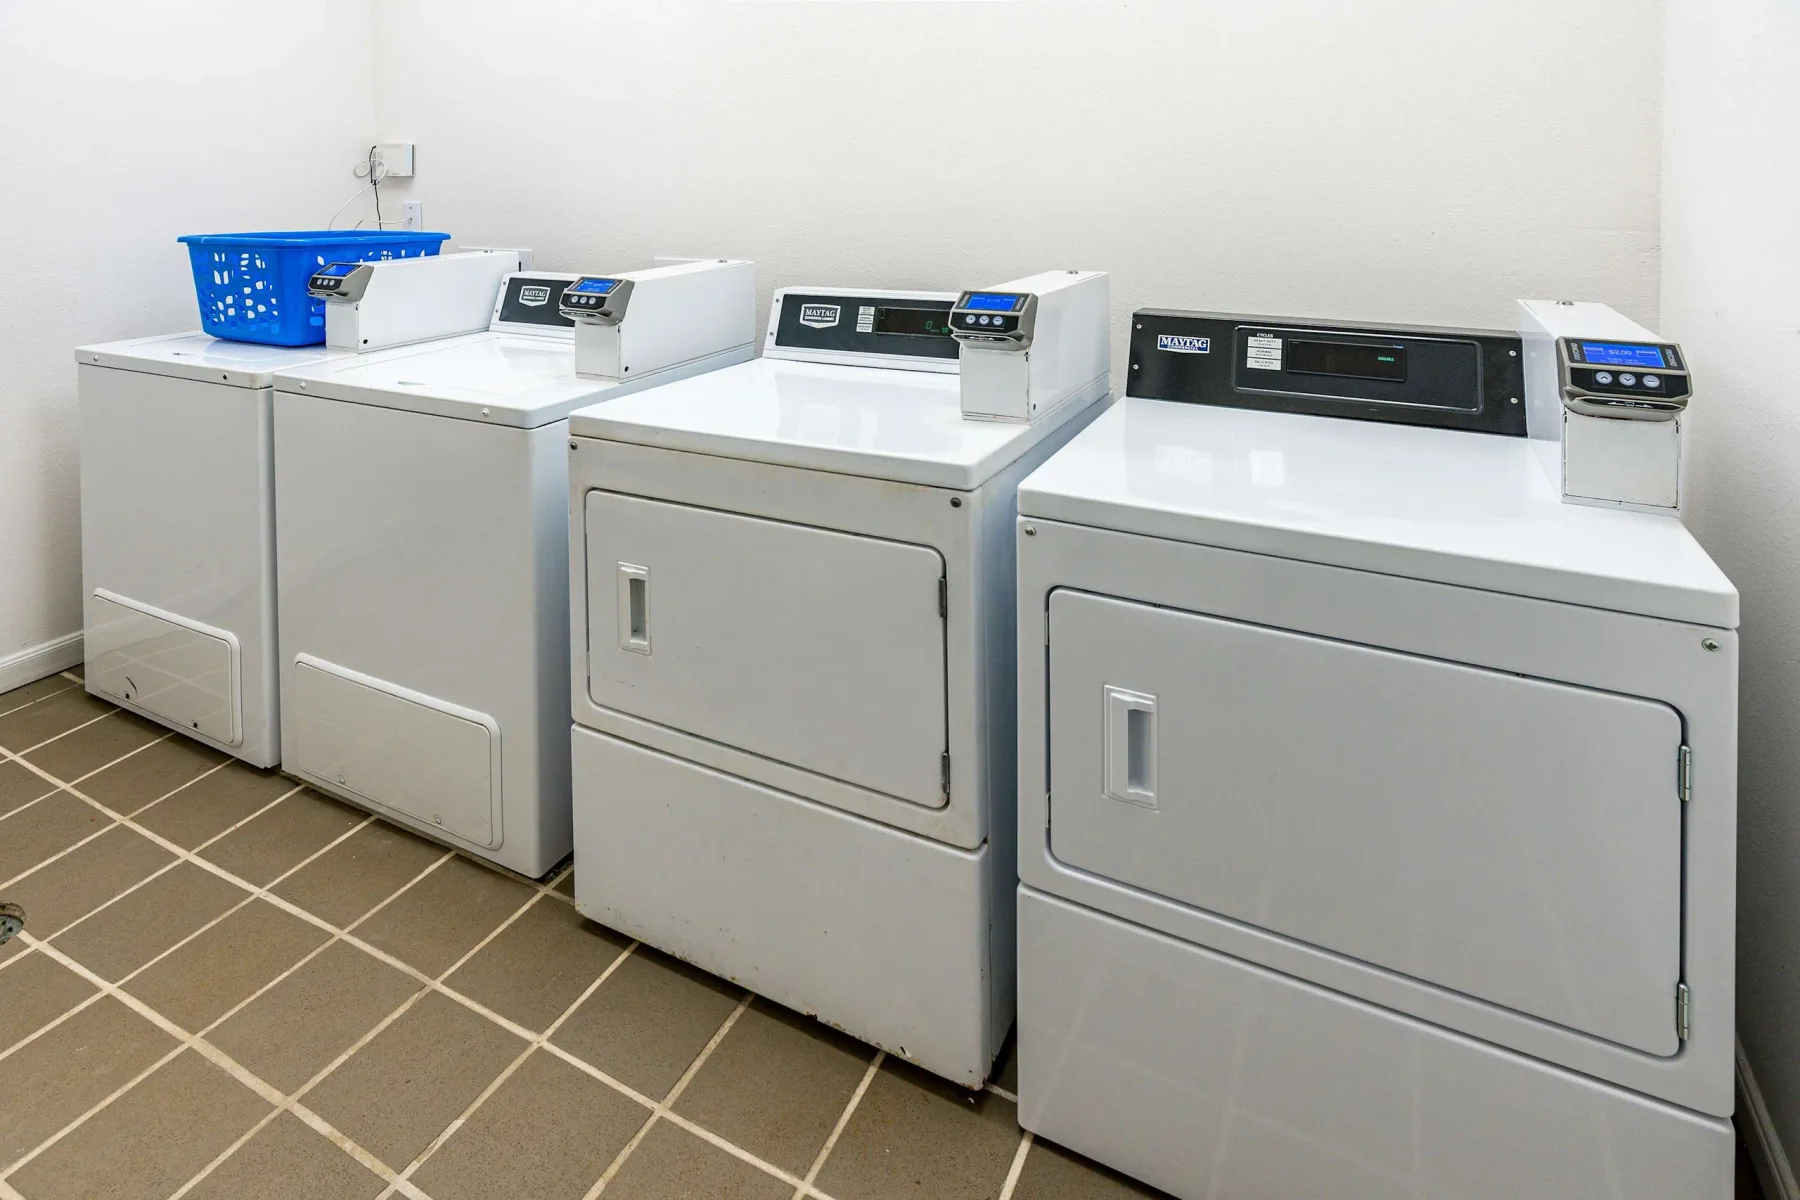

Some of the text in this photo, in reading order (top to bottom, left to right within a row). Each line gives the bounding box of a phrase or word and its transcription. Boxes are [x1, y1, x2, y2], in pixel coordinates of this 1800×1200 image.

[523, 289, 547, 297] MAYTAG
[805, 308, 836, 317] MAYTAG
[1160, 336, 1207, 348] MAYTAG
